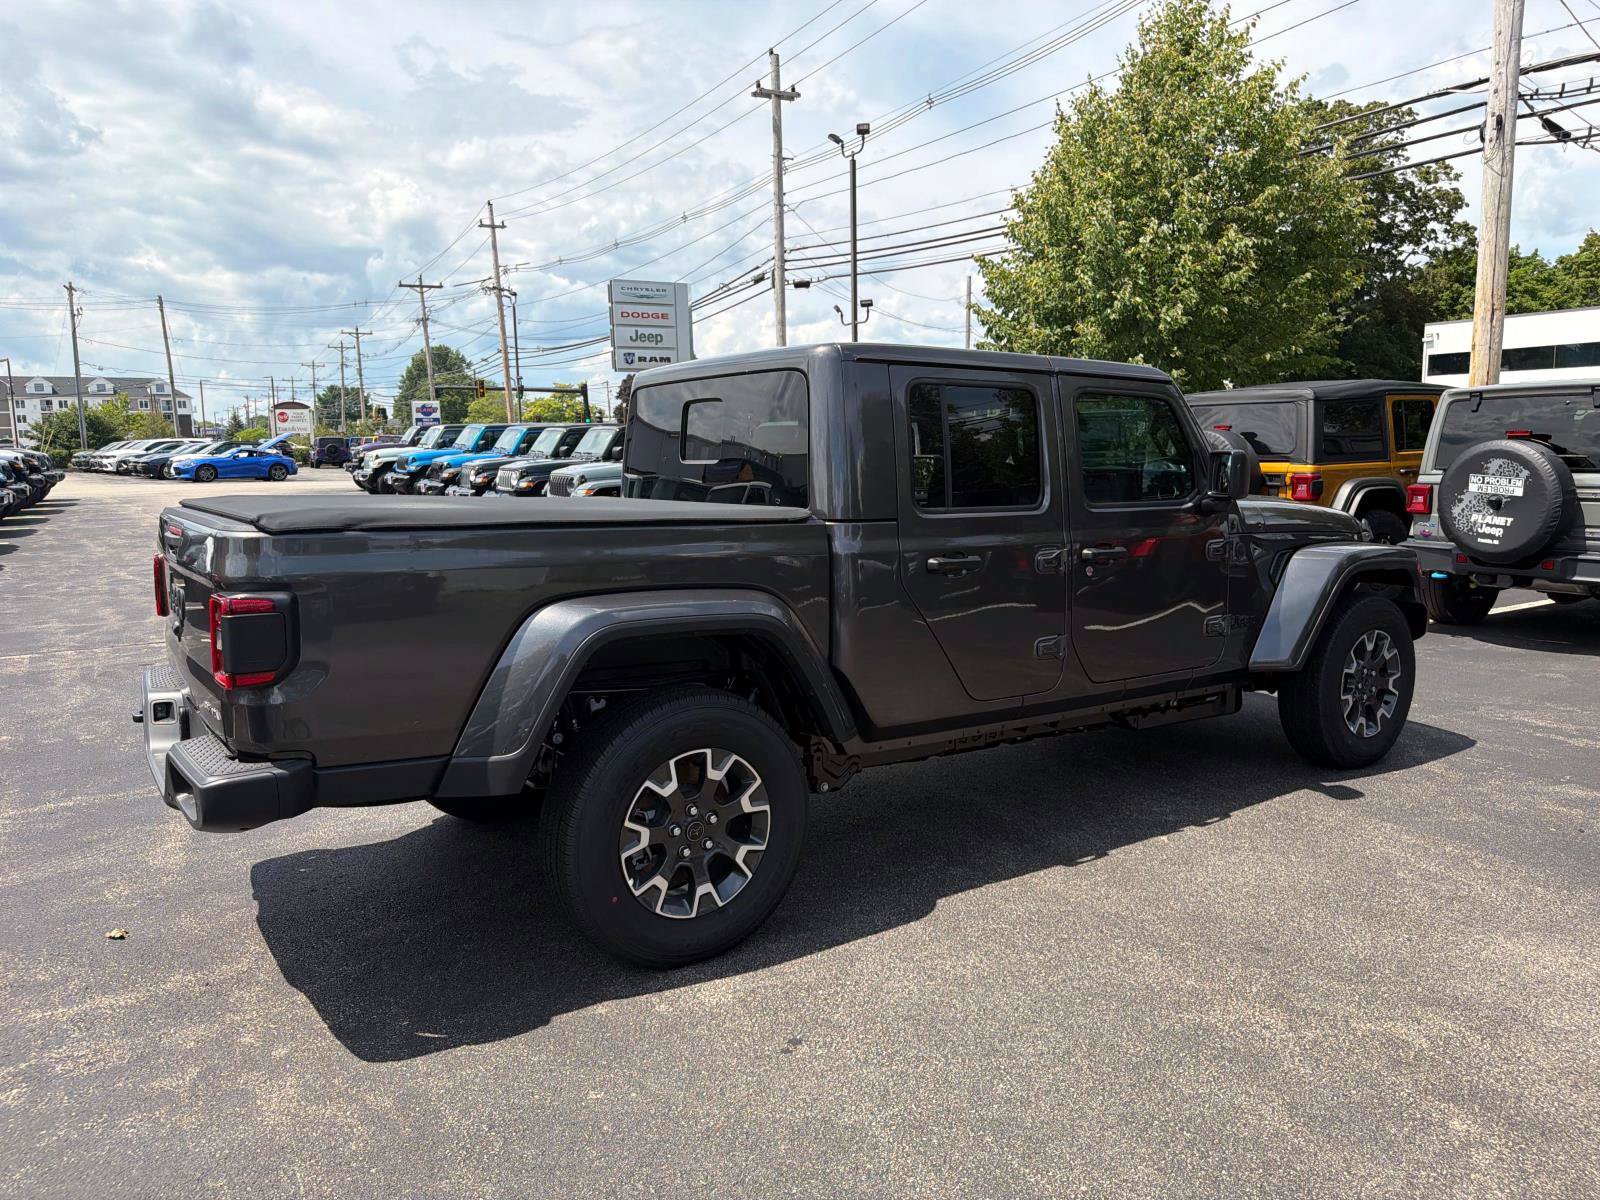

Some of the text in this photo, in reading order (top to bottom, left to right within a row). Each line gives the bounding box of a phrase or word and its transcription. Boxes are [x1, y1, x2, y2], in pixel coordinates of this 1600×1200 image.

[620, 312, 669, 320] DODGE
[630, 329, 664, 345] Jeep
[1470, 476, 1523, 488] NO PROBLEM
[1477, 486, 1514, 494] PROBLEM
[1470, 514, 1514, 526] PLANET
[1478, 524, 1504, 538] Jeep
